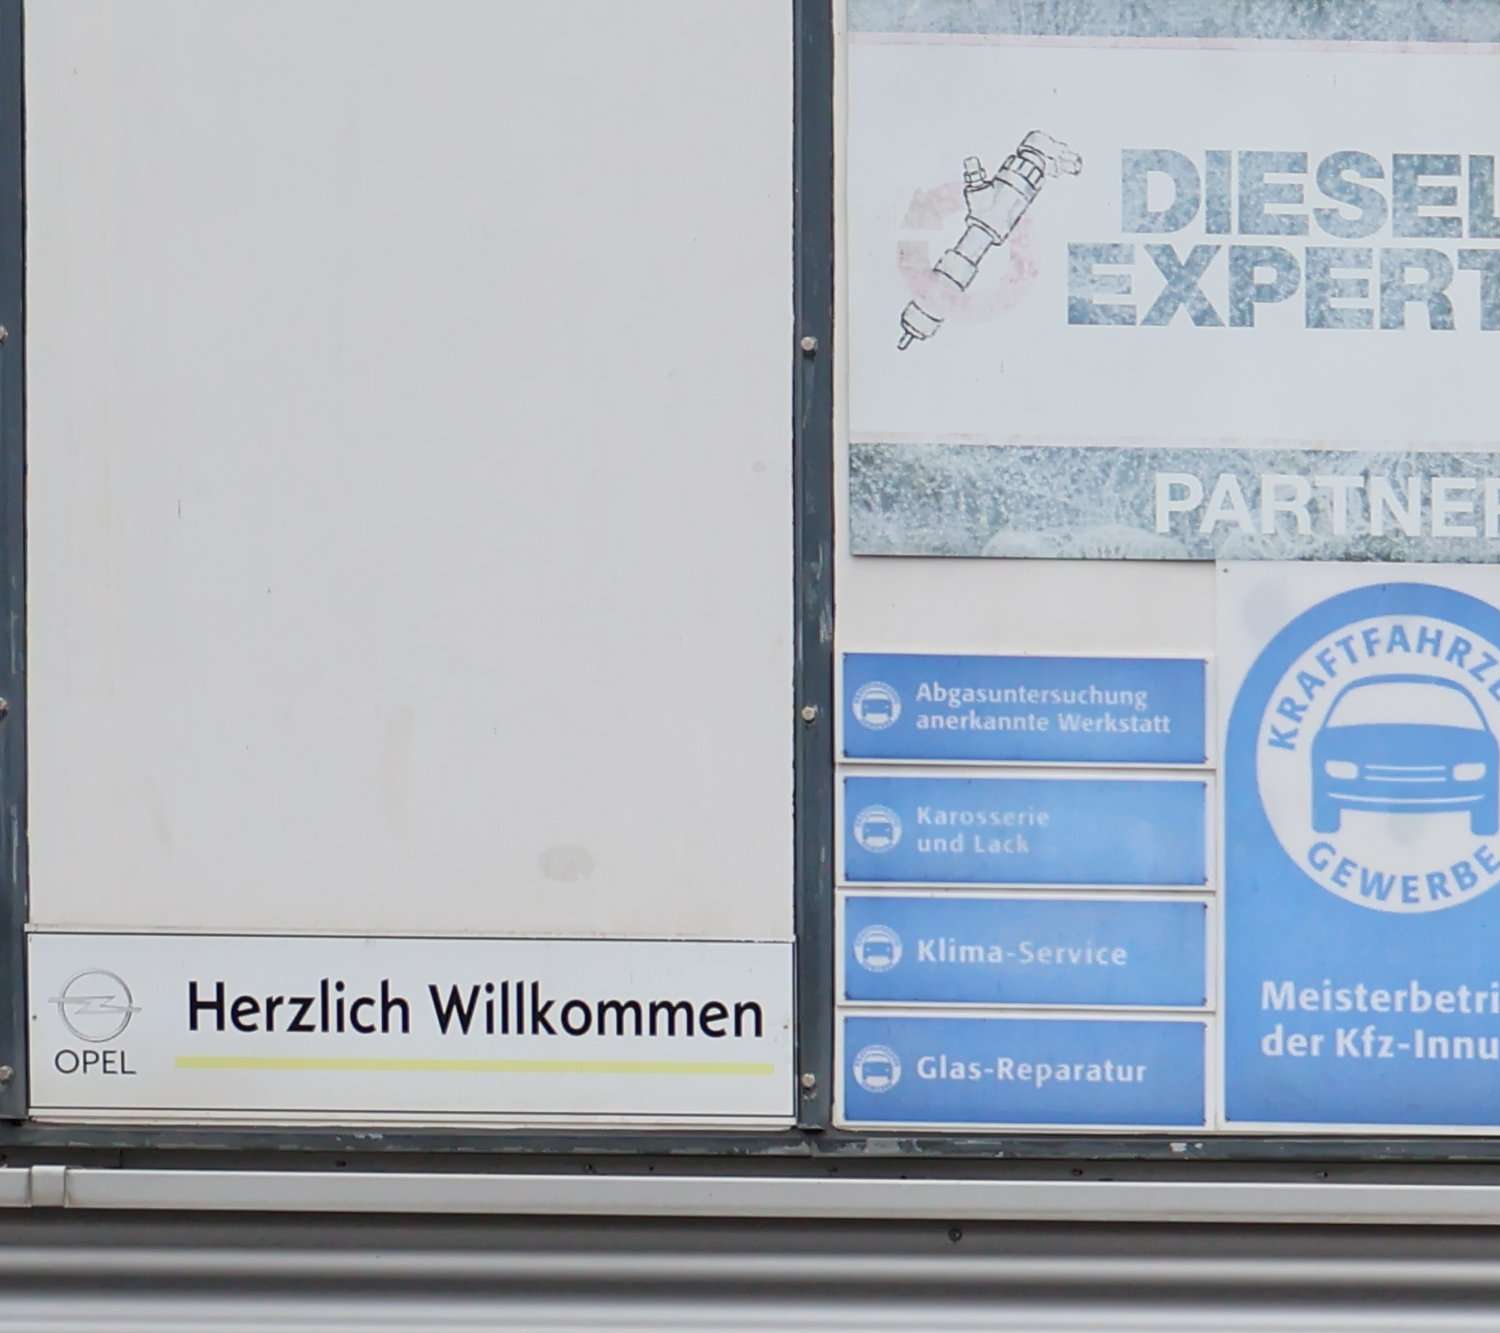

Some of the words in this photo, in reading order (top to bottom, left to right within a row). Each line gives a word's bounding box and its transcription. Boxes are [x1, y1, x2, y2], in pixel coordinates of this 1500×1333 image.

[915, 682, 1148, 711] Abgasuntersuchung
[915, 710, 1050, 732] anerkannte
[1057, 713, 1172, 733] Werkstatt
[916, 805, 1050, 827] Karosserie
[916, 833, 964, 853] und
[974, 834, 1030, 854] Lack
[917, 937, 1129, 966] Klima-Service
[188, 978, 410, 1034] Herzlich
[427, 981, 765, 1038] Willkommen
[1260, 1025, 1323, 1059] der
[54, 1049, 137, 1075] OPEL
[916, 1056, 1148, 1087] Glas-Reparatur
